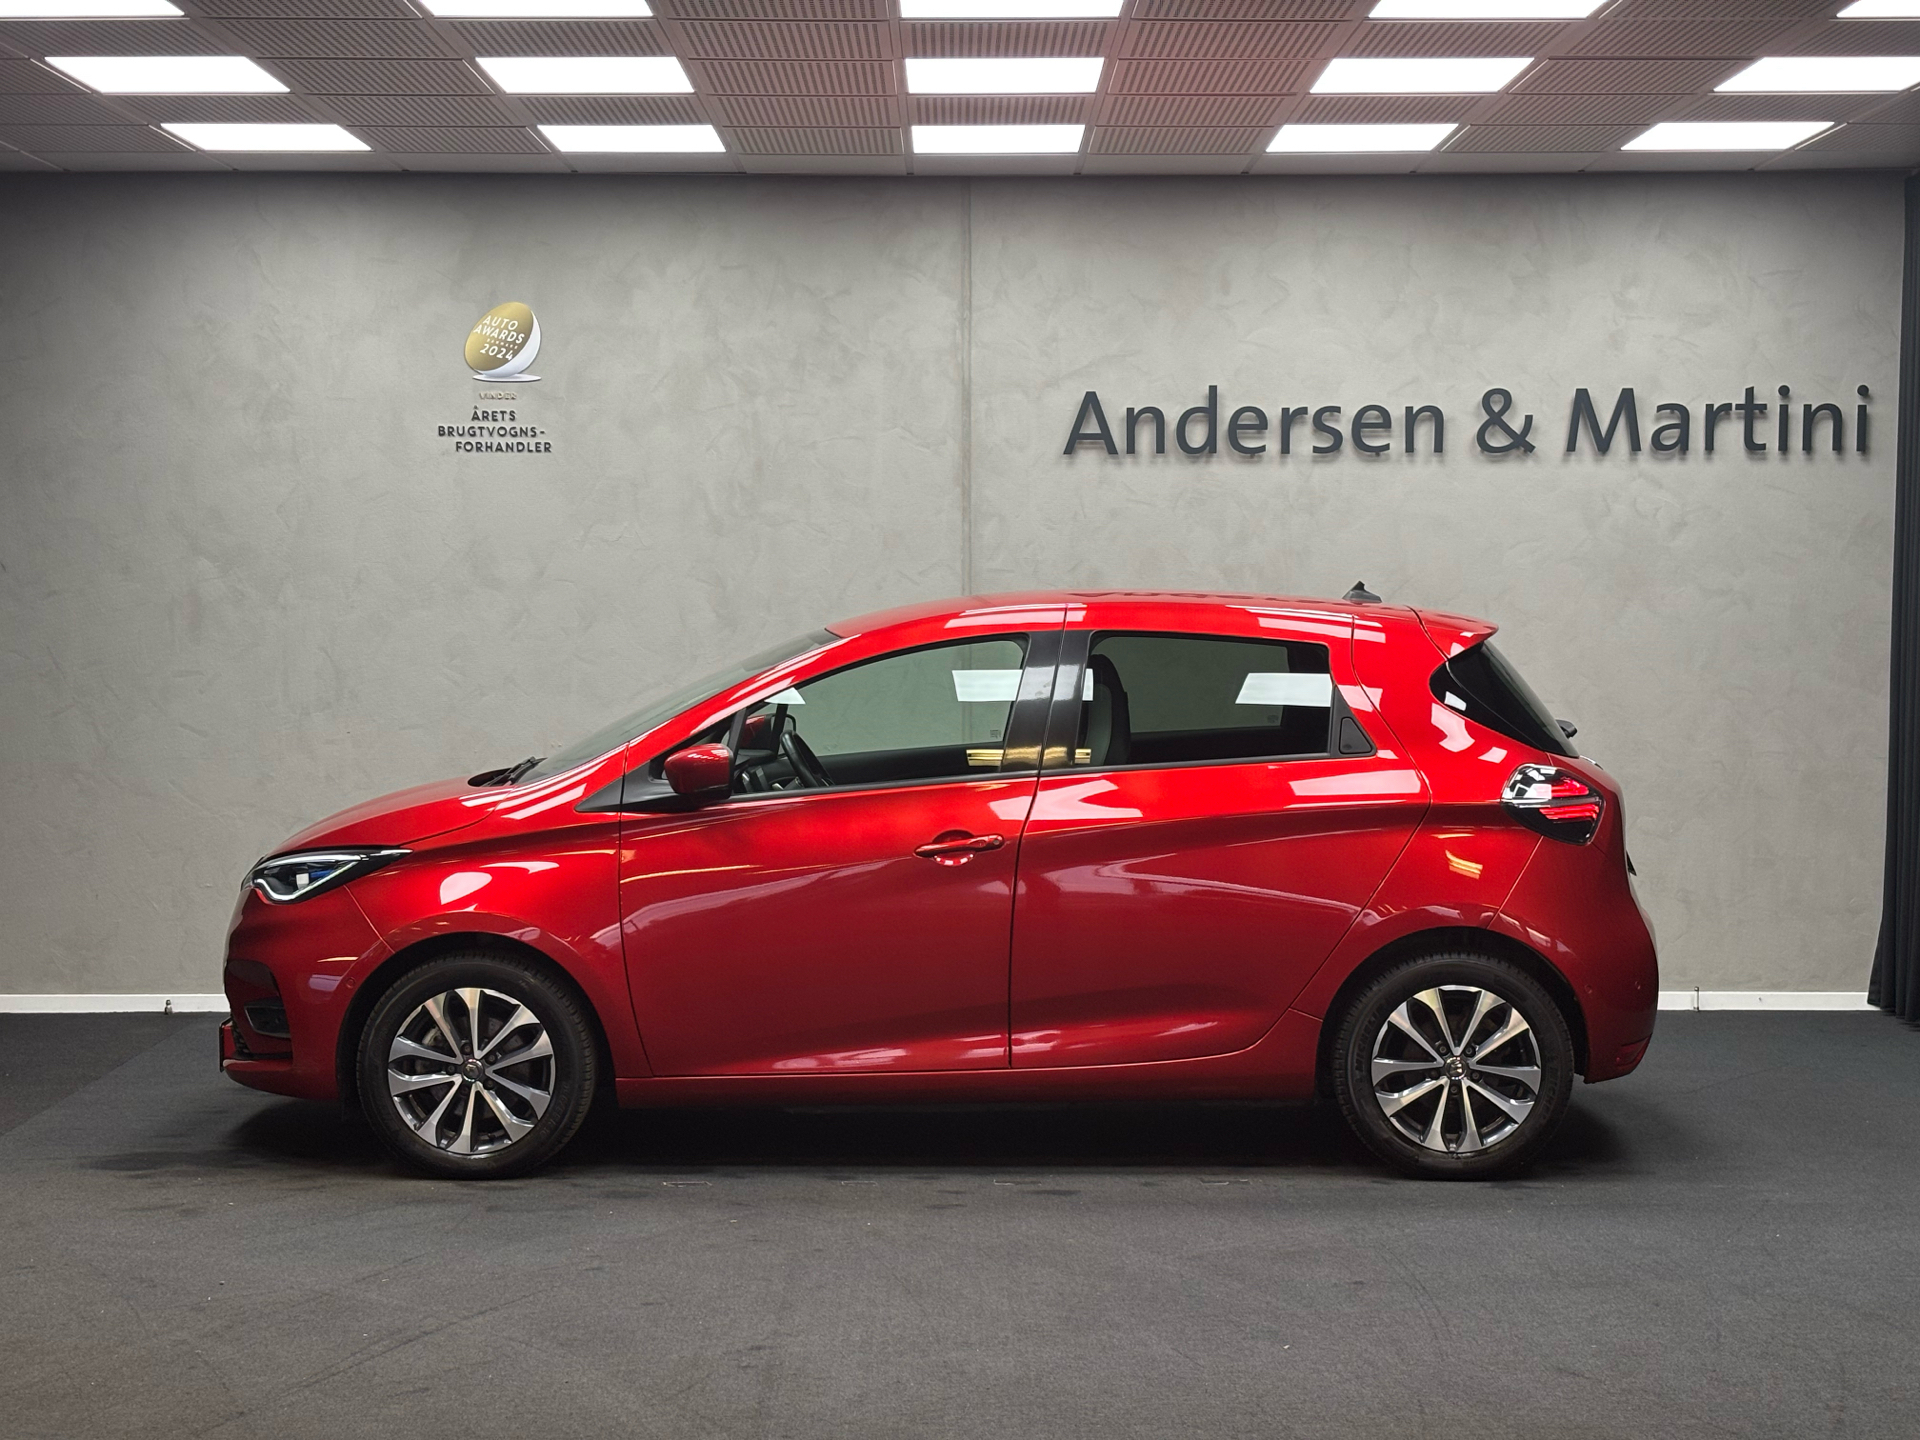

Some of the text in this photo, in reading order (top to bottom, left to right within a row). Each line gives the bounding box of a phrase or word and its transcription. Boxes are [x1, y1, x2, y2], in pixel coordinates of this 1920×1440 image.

[482, 315, 519, 331] AUTO
[473, 324, 525, 344] AWARDS
[479, 343, 514, 361] 2024
[479, 391, 518, 400] VINDER
[471, 405, 516, 422] ÅRETS
[1062, 384, 1870, 455] Andersen & Martini
[438, 425, 545, 437] BRUGTVOGNS-
[455, 441, 552, 453] FORHANDLER
